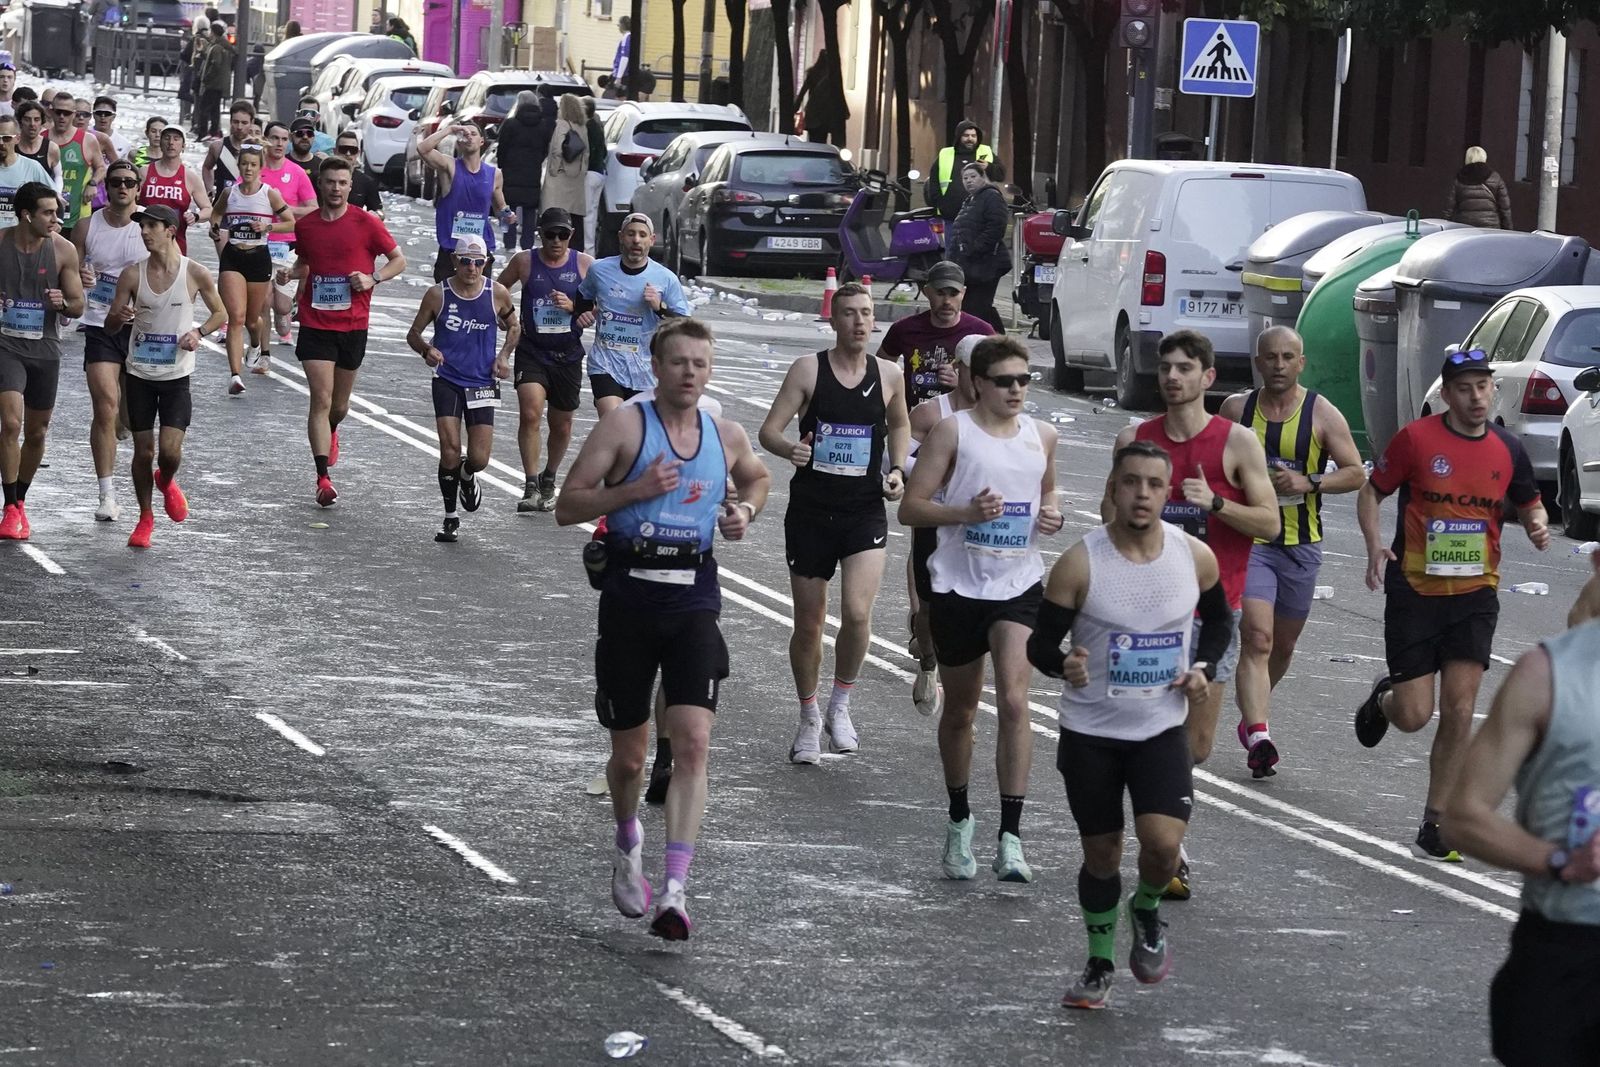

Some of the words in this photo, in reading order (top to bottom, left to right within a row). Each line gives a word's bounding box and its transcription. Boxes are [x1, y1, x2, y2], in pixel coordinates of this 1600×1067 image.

[145, 184, 183, 201] DCRR
[456, 226, 481, 234] THOMAS
[774, 238, 799, 248] 4249
[801, 239, 821, 249] GBR
[319, 294, 344, 302] HARRY
[1188, 301, 1218, 313] 9177
[1221, 303, 1245, 315] MFY
[461, 318, 490, 334] Pfizer
[542, 316, 563, 326] DINIS
[147, 335, 173, 343] ZURICH
[617, 337, 639, 345] ANGEL
[474, 390, 496, 399] FABIO
[835, 427, 866, 436] ZURICH
[834, 442, 852, 450] 6278
[829, 451, 855, 464] PAUL
[1163, 505, 1201, 515] ZURICH
[1449, 523, 1482, 531] ZURICH
[658, 527, 698, 539] ZURICH
[965, 530, 991, 544] SAM
[993, 534, 1029, 546] MACEY
[656, 545, 680, 556] 5072
[1431, 550, 1482, 562] CHARLES
[1136, 636, 1177, 648] ZURICH
